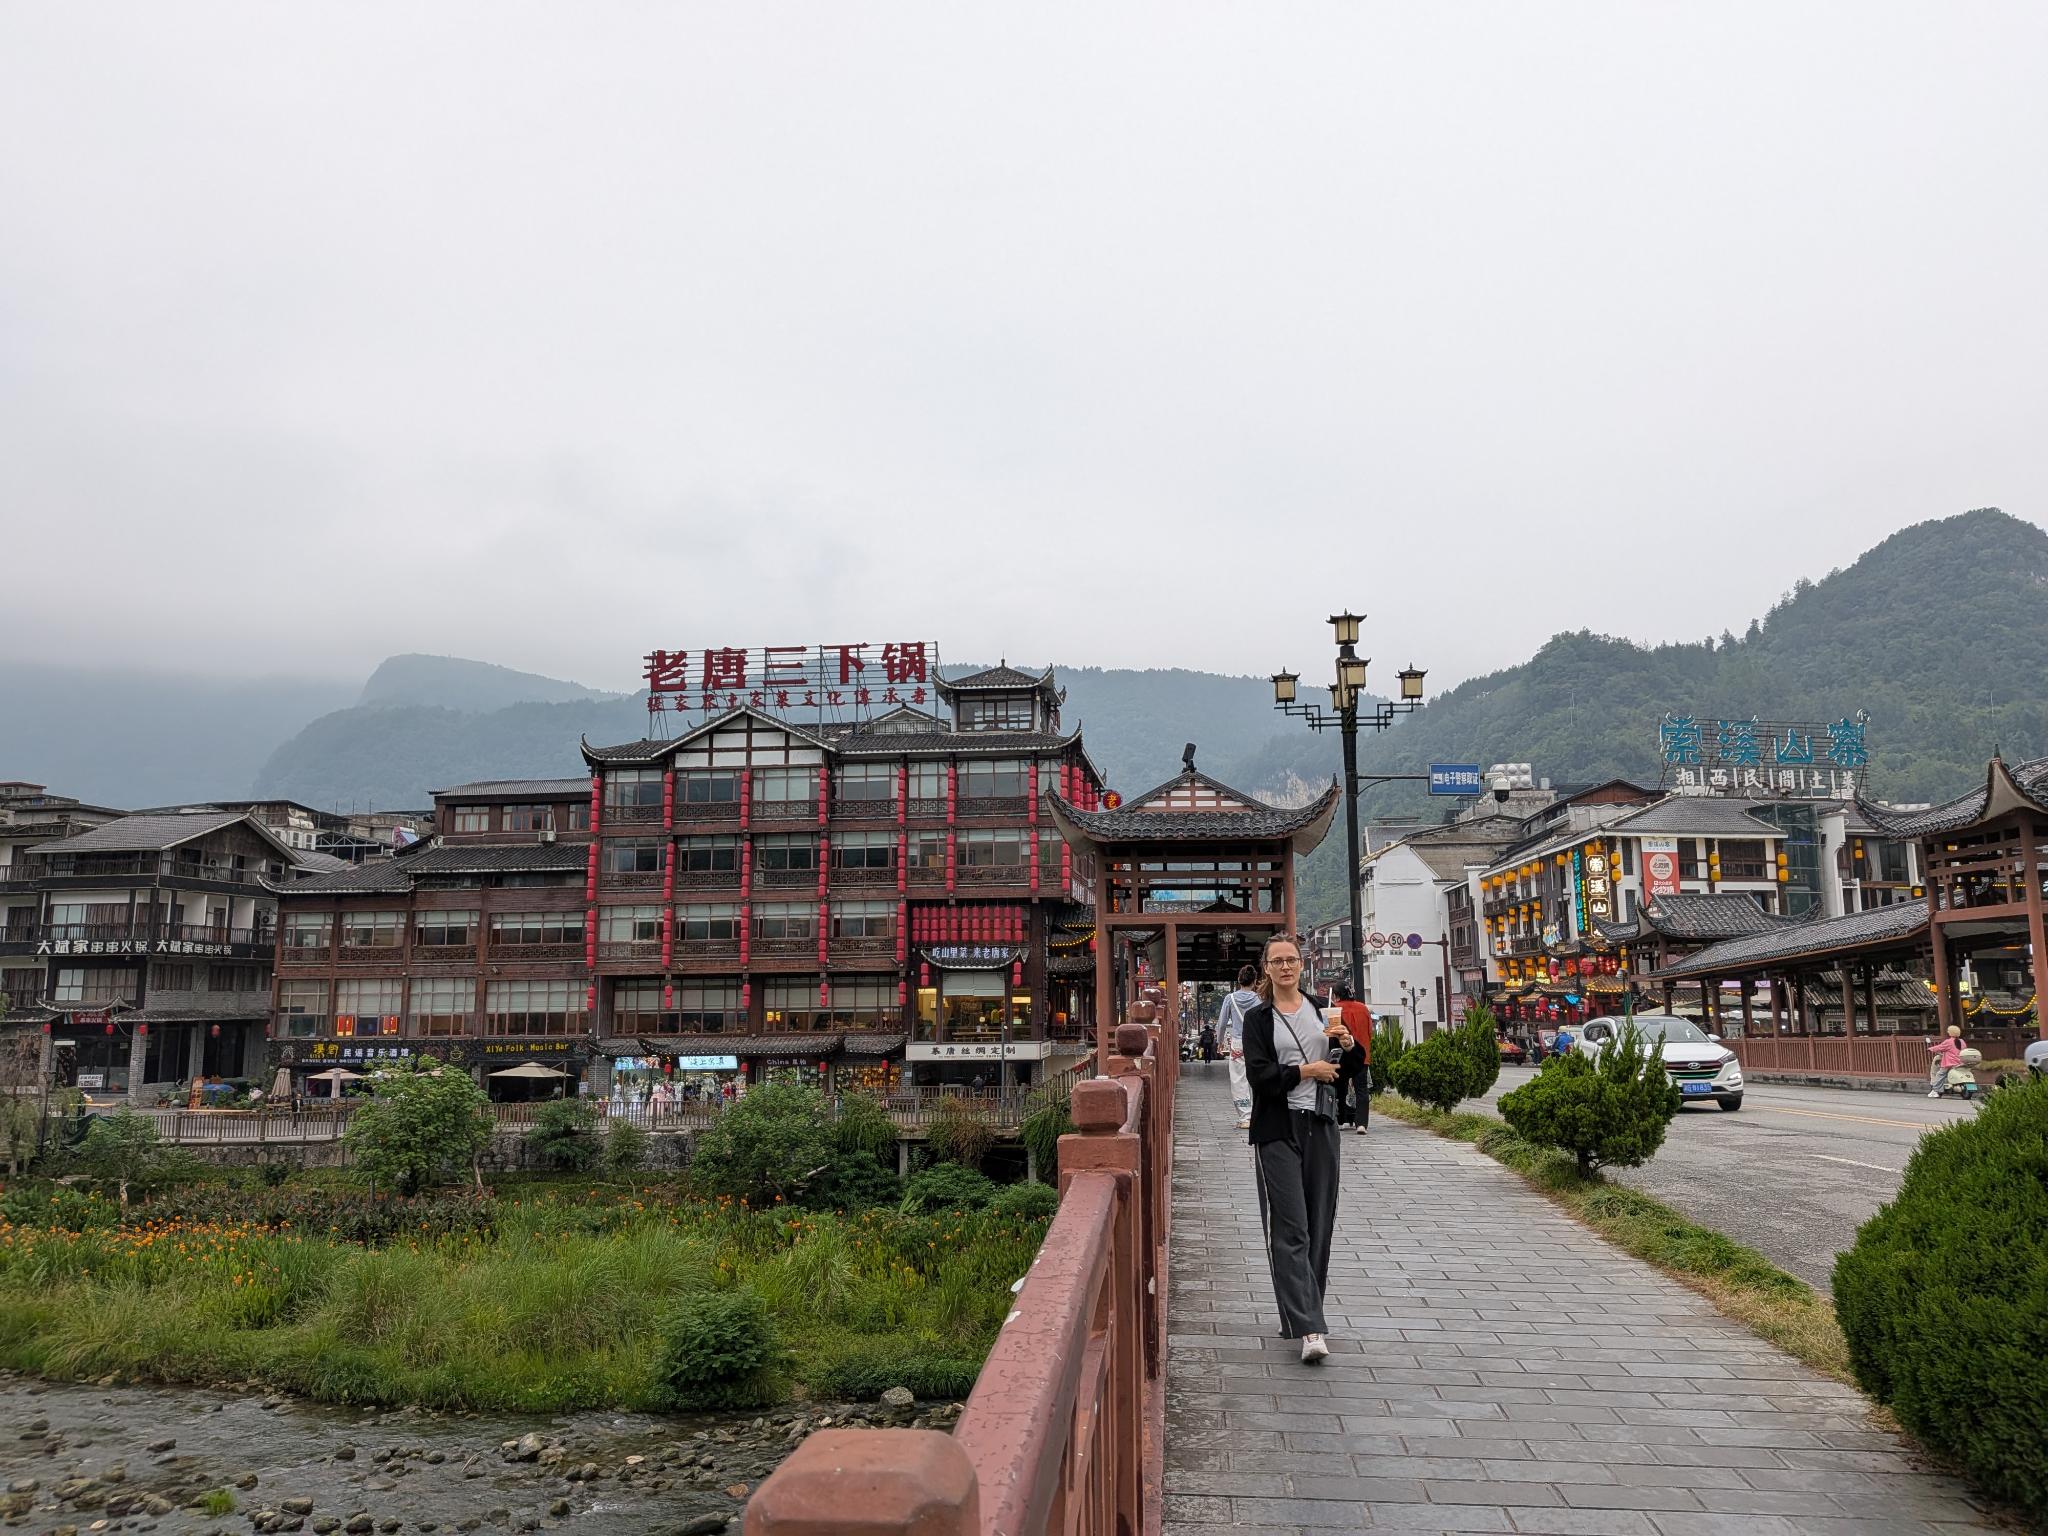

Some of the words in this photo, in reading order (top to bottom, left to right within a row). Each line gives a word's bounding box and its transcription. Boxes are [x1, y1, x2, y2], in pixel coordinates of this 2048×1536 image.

[643, 641, 927, 691] 老唐三下锅
[37, 940, 148, 955] 大斌家串串火锅
[156, 940, 232, 955] 大斌家串串火锅
[1392, 937, 1401, 945] 50
[932, 947, 968, 958] 吃山里菜
[973, 947, 1009, 958] 来老唐家
[505, 1044, 524, 1052] Folk
[530, 1043, 552, 1051] Music
